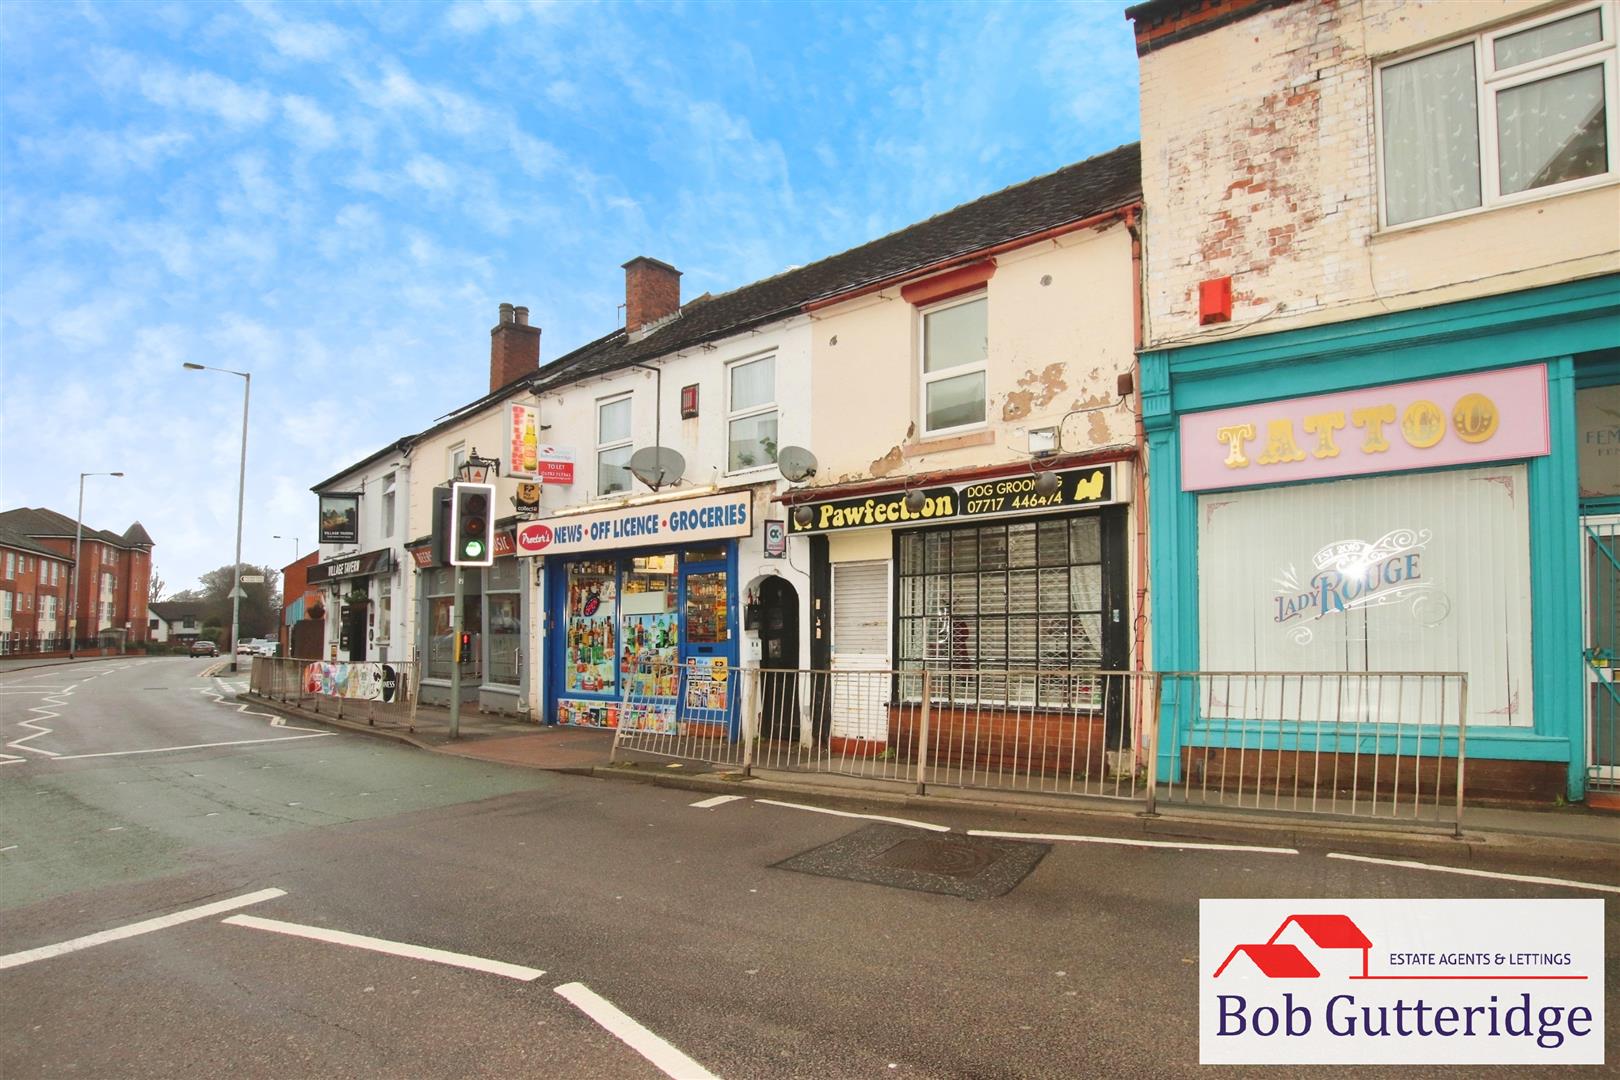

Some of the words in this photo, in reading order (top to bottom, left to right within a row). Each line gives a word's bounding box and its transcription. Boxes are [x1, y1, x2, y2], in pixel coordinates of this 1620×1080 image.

[1216, 392, 1499, 469] TATTOO
[967, 485, 993, 498] DOG
[996, 475, 1063, 494] GROOG
[818, 495, 953, 529] Pawfecton
[967, 498, 1005, 513] 07717
[553, 524, 583, 544] NEWS
[590, 520, 611, 541] OFF
[613, 513, 659, 539] LICENCE
[669, 502, 747, 532] GROCERIES
[327, 563, 344, 577] VILLAGE
[344, 559, 360, 574] TAVERN
[1274, 589, 1320, 623] LADY
[1310, 553, 1422, 620] ROUGE
